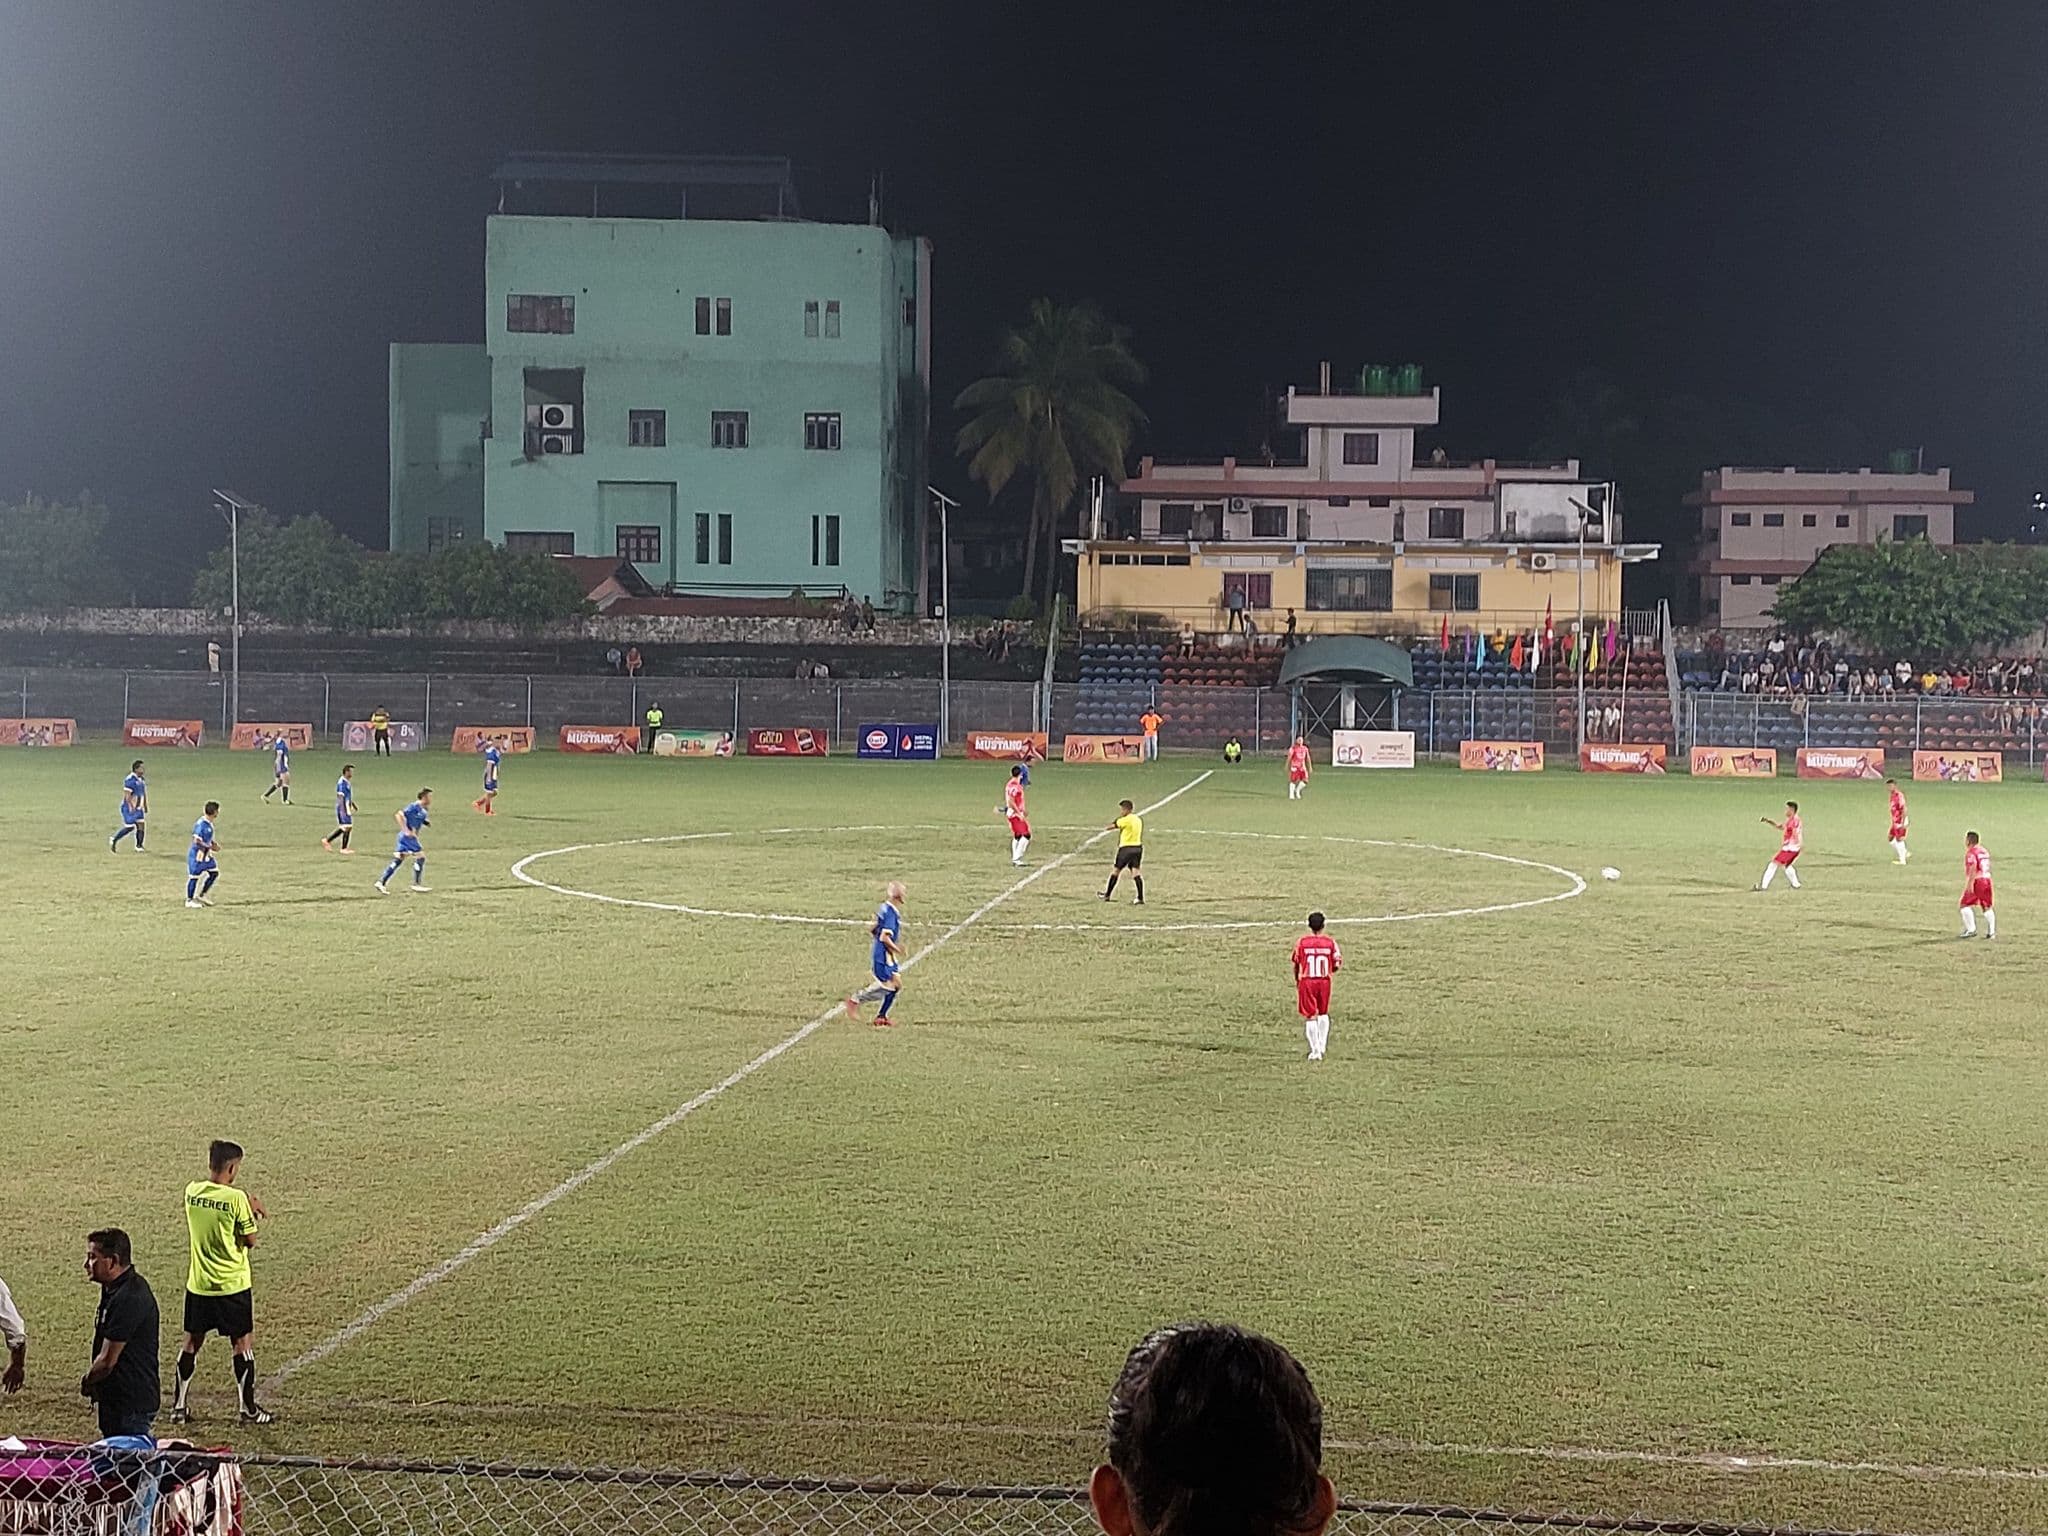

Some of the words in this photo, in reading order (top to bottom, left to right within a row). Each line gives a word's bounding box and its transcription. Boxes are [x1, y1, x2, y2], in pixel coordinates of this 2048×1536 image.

[401, 724, 415, 736] 8%
[758, 731, 783, 744] GOLD
[1307, 954, 1329, 978] 10
